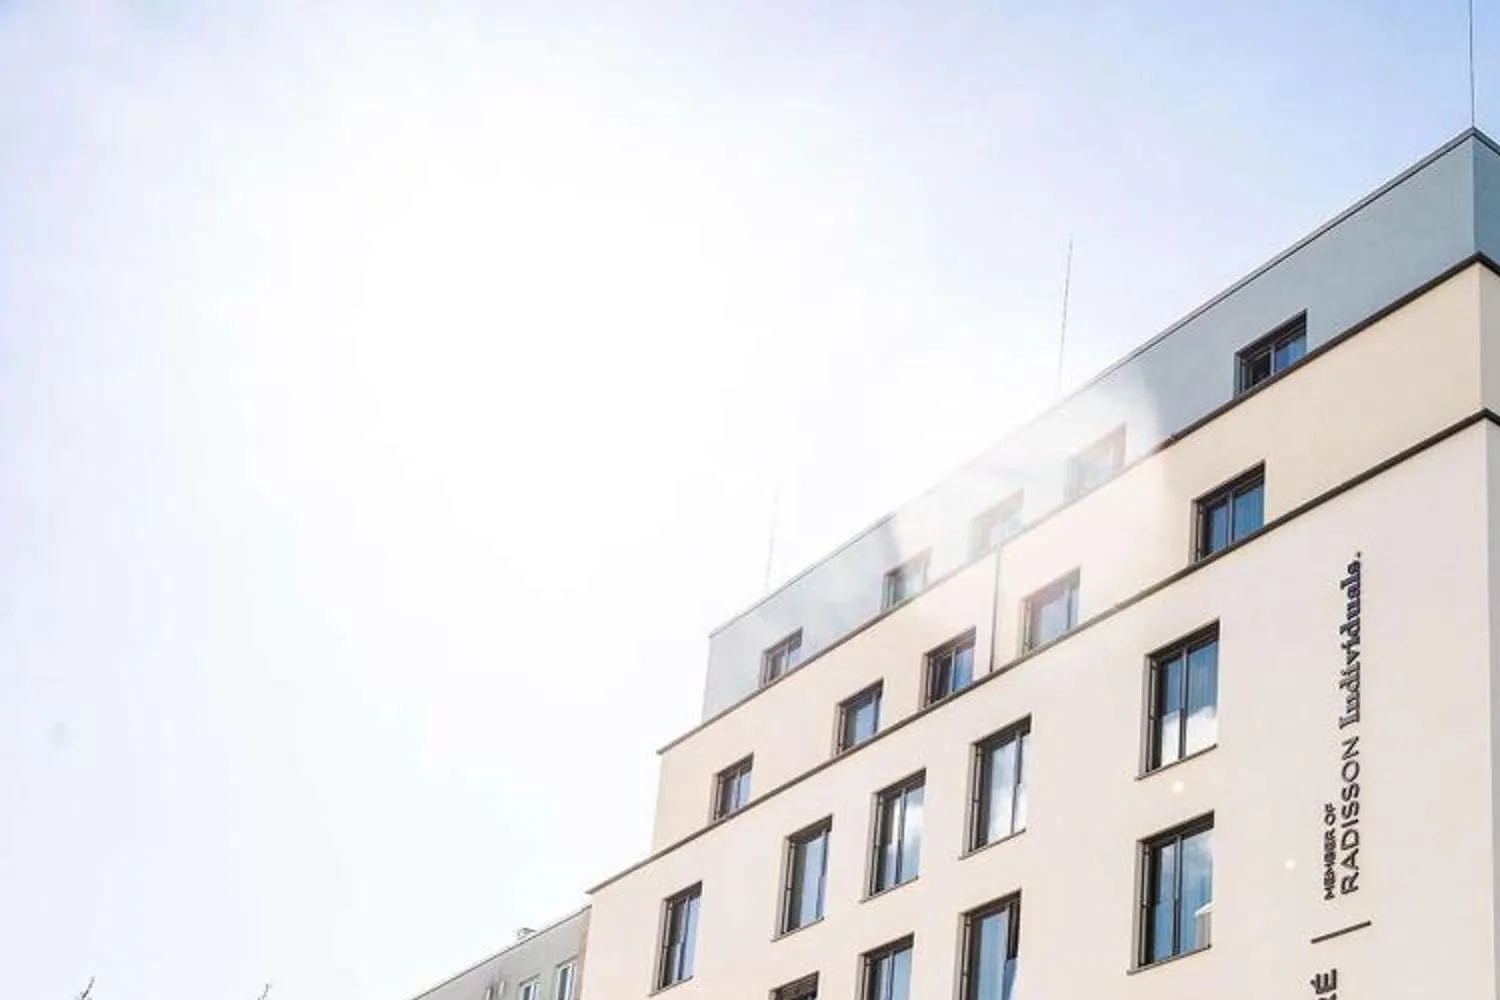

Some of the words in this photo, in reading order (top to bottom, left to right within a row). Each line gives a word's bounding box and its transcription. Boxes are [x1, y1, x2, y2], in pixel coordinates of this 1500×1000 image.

[1323, 802, 1337, 827] OF
[1340, 735, 1361, 896] RADISSON
[1323, 827, 1337, 901] MEMBER
